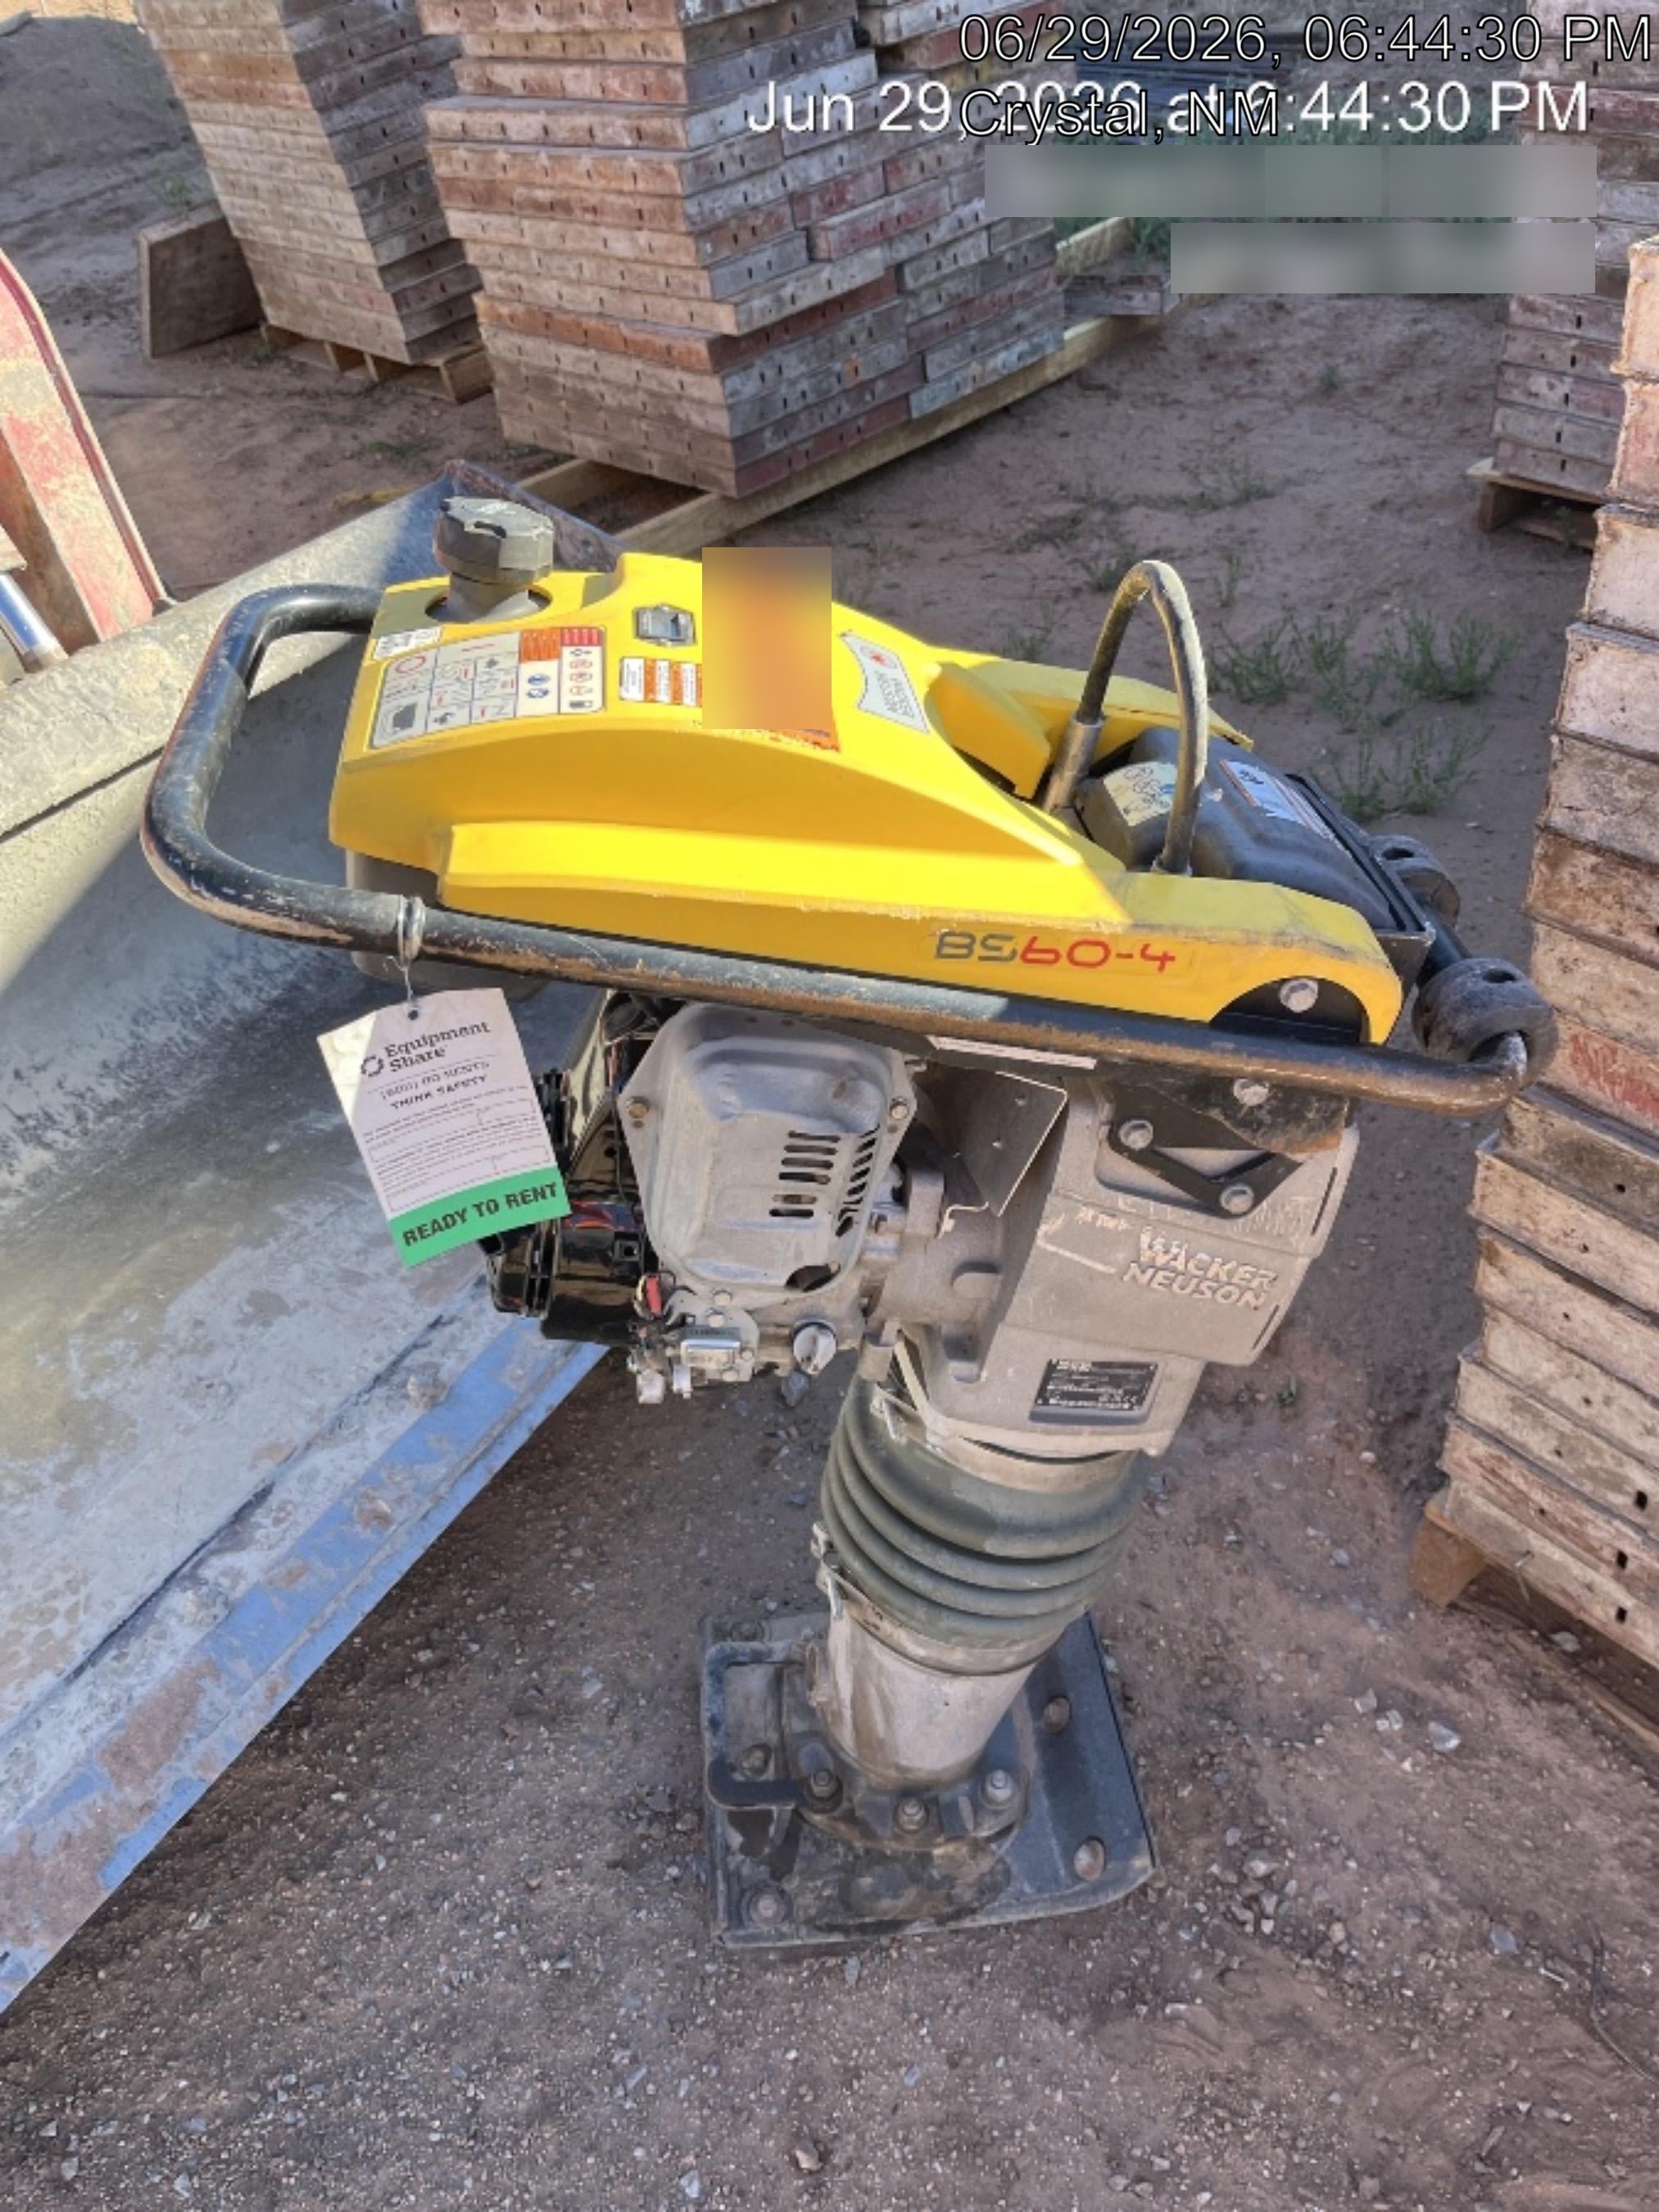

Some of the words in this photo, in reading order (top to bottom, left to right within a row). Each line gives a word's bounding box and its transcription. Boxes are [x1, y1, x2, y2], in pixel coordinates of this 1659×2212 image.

[934, 930, 1176, 973] BS60-4
[383, 1021, 492, 1058] Equipment
[388, 1048, 446, 1072] Share
[402, 1206, 469, 1248] READY
[473, 1197, 501, 1220] TO
[505, 1181, 559, 1208] RENT
[1139, 1231, 1279, 1291] WACKER
[1122, 1262, 1269, 1311] NEUSON
